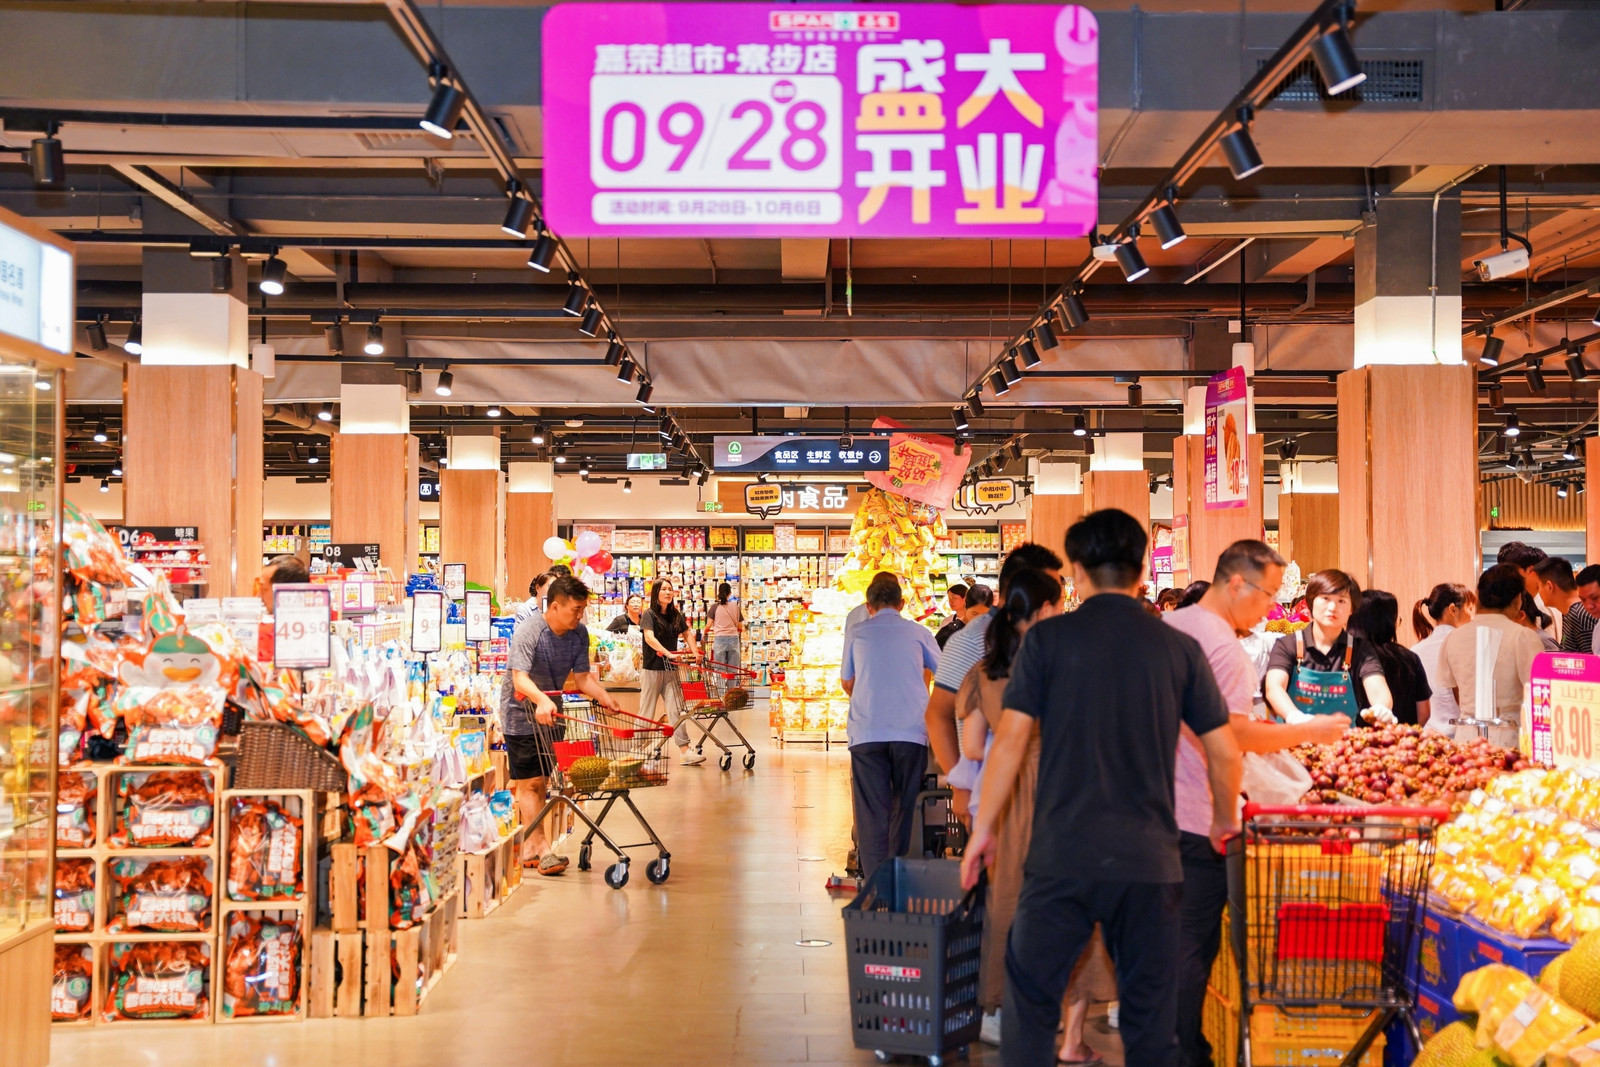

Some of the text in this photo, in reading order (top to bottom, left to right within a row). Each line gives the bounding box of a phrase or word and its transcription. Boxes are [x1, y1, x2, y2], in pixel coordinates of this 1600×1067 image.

[856, 38, 1045, 131] 盛大
[602, 100, 827, 173] 09/28
[856, 133, 1045, 225] 开业
[774, 450, 799, 459] 食品区
[119, 529, 139, 544] 06
[175, 528, 195, 538] 糖果
[325, 546, 341, 556] 08
[276, 621, 329, 640] 49.90
[1298, 681, 1321, 692] SPAR
[1554, 704, 1592, 759] 8.90
[869, 966, 893, 975] SPAR
